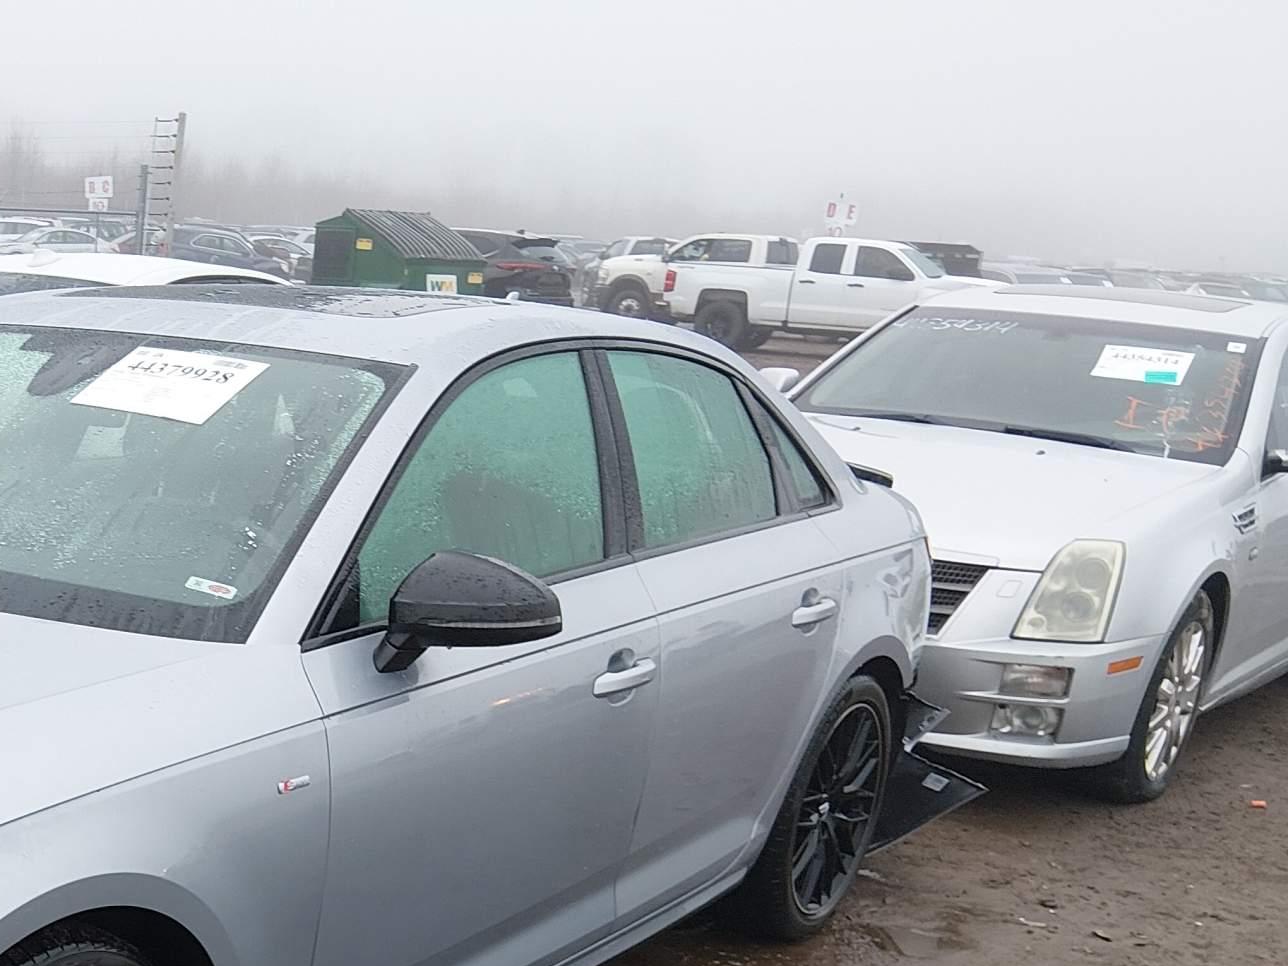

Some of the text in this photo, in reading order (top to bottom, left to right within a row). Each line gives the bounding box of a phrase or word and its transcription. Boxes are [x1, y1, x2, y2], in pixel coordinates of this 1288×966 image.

[826, 202, 856, 220] D E
[127, 360, 235, 385] 44379928
